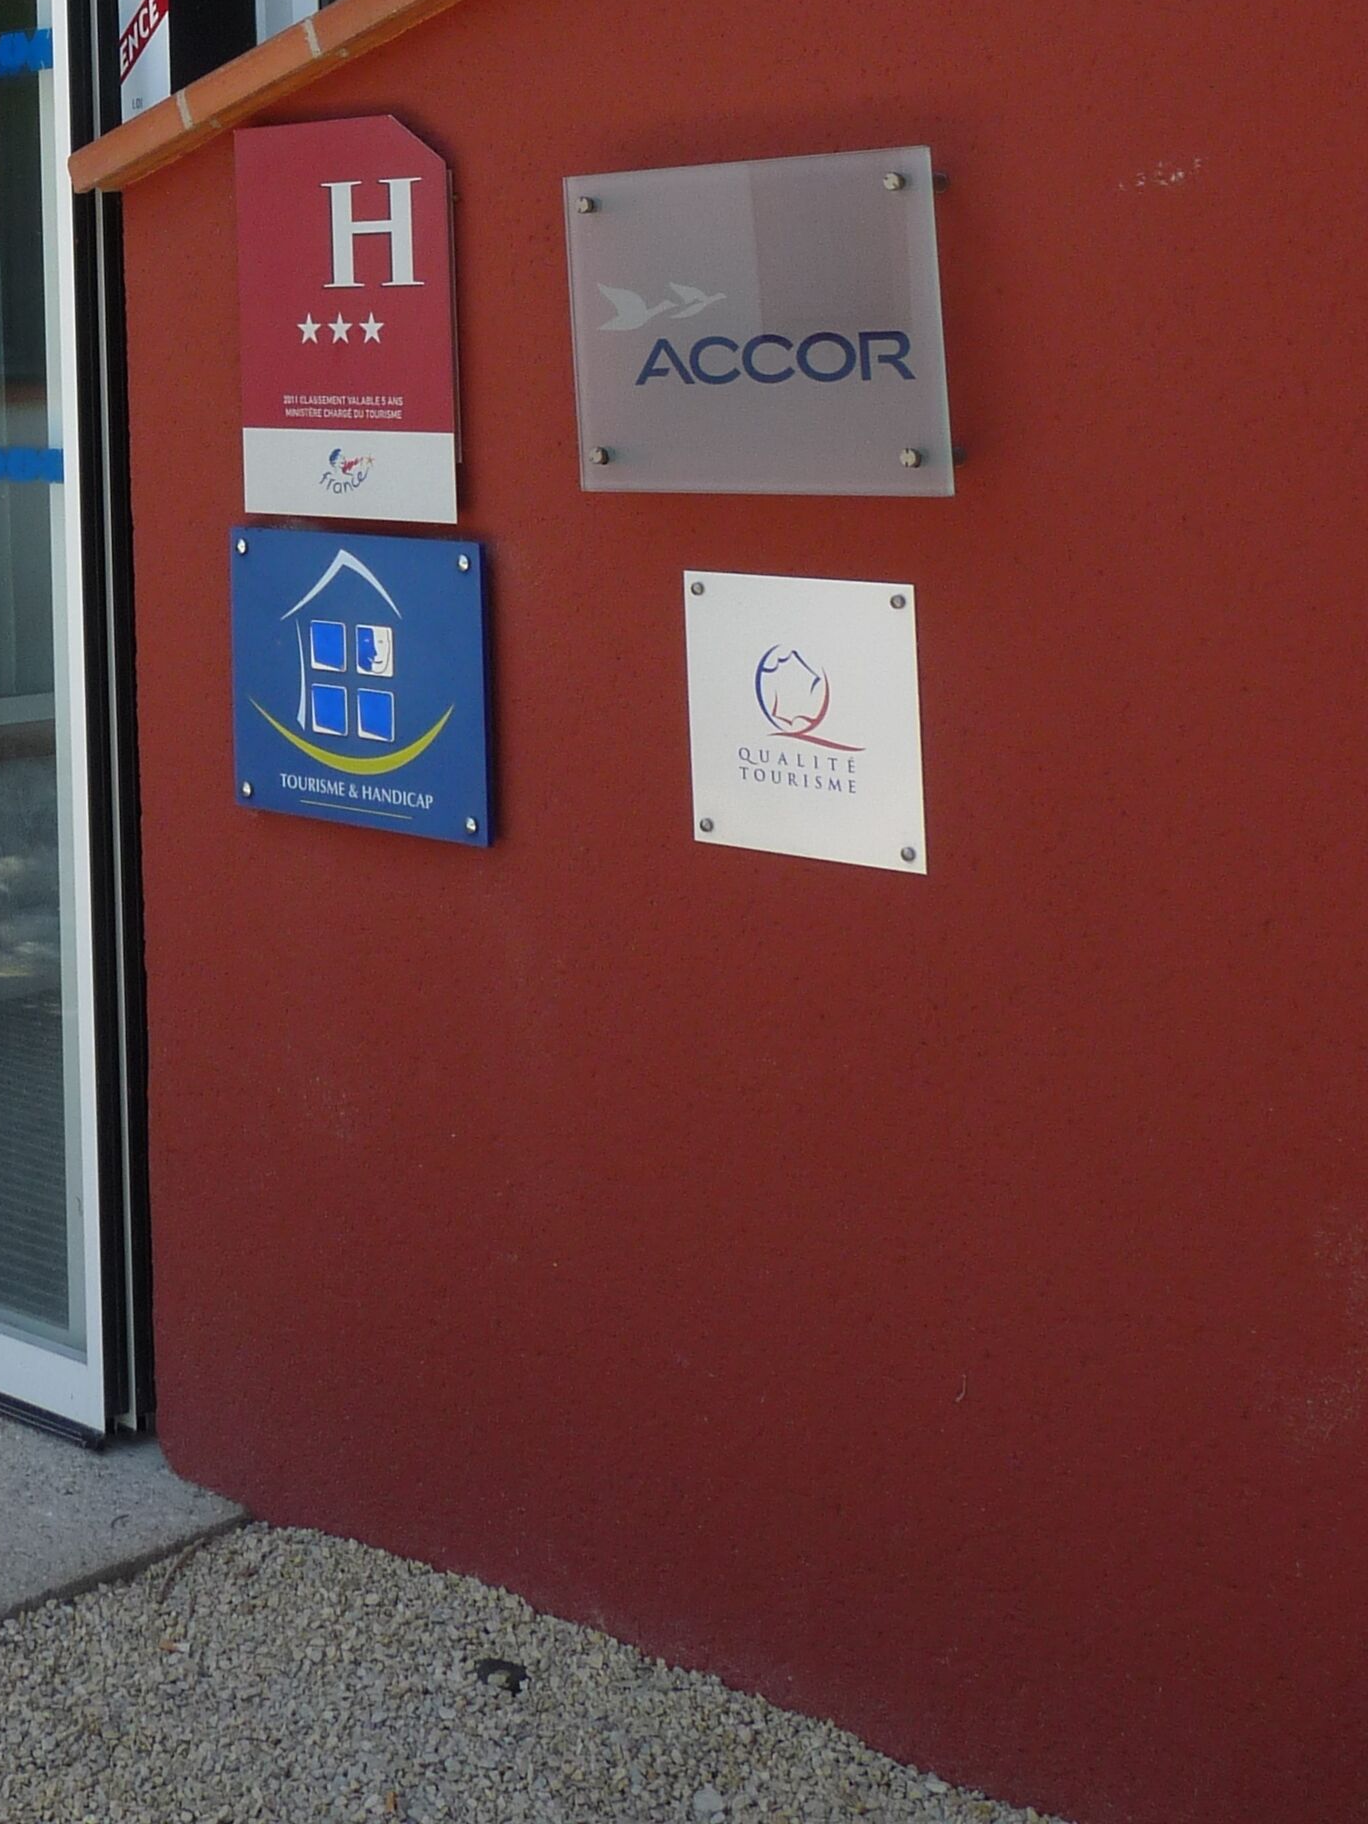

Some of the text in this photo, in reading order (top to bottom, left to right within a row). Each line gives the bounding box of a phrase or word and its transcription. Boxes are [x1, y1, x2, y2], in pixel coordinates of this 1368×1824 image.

[320, 177, 425, 288] H
[635, 330, 916, 387] ACCOR
[299, 395, 346, 406] CLASSEMENT
[347, 395, 380, 406] VALABLE
[387, 396, 403, 406] ANS
[353, 409, 364, 419] DU
[365, 409, 403, 420] TOURISME
[280, 773, 434, 810] TOURISME & HANDICAP
[738, 766, 857, 794] TOURISME
